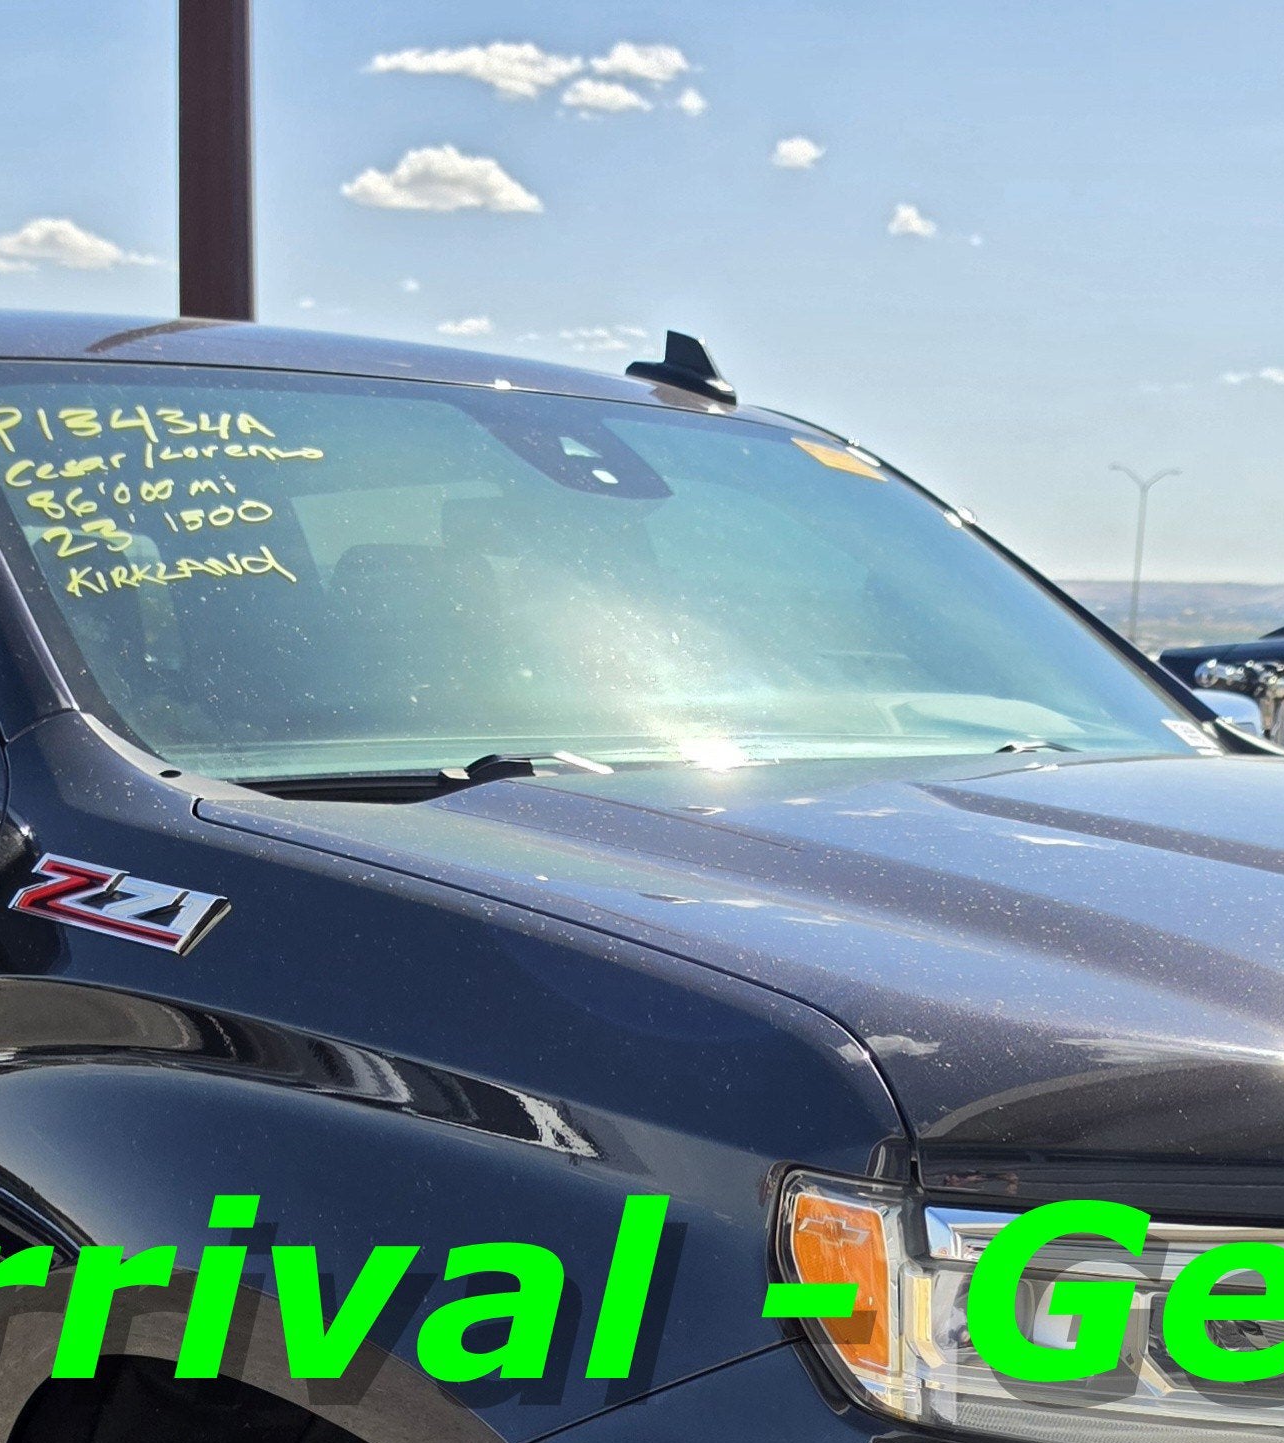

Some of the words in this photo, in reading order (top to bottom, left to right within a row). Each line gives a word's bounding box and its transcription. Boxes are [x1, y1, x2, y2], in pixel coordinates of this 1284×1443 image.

[189, 474, 237, 496] mi
[163, 500, 273, 533] 1500
[8, 852, 232, 957] Z71
